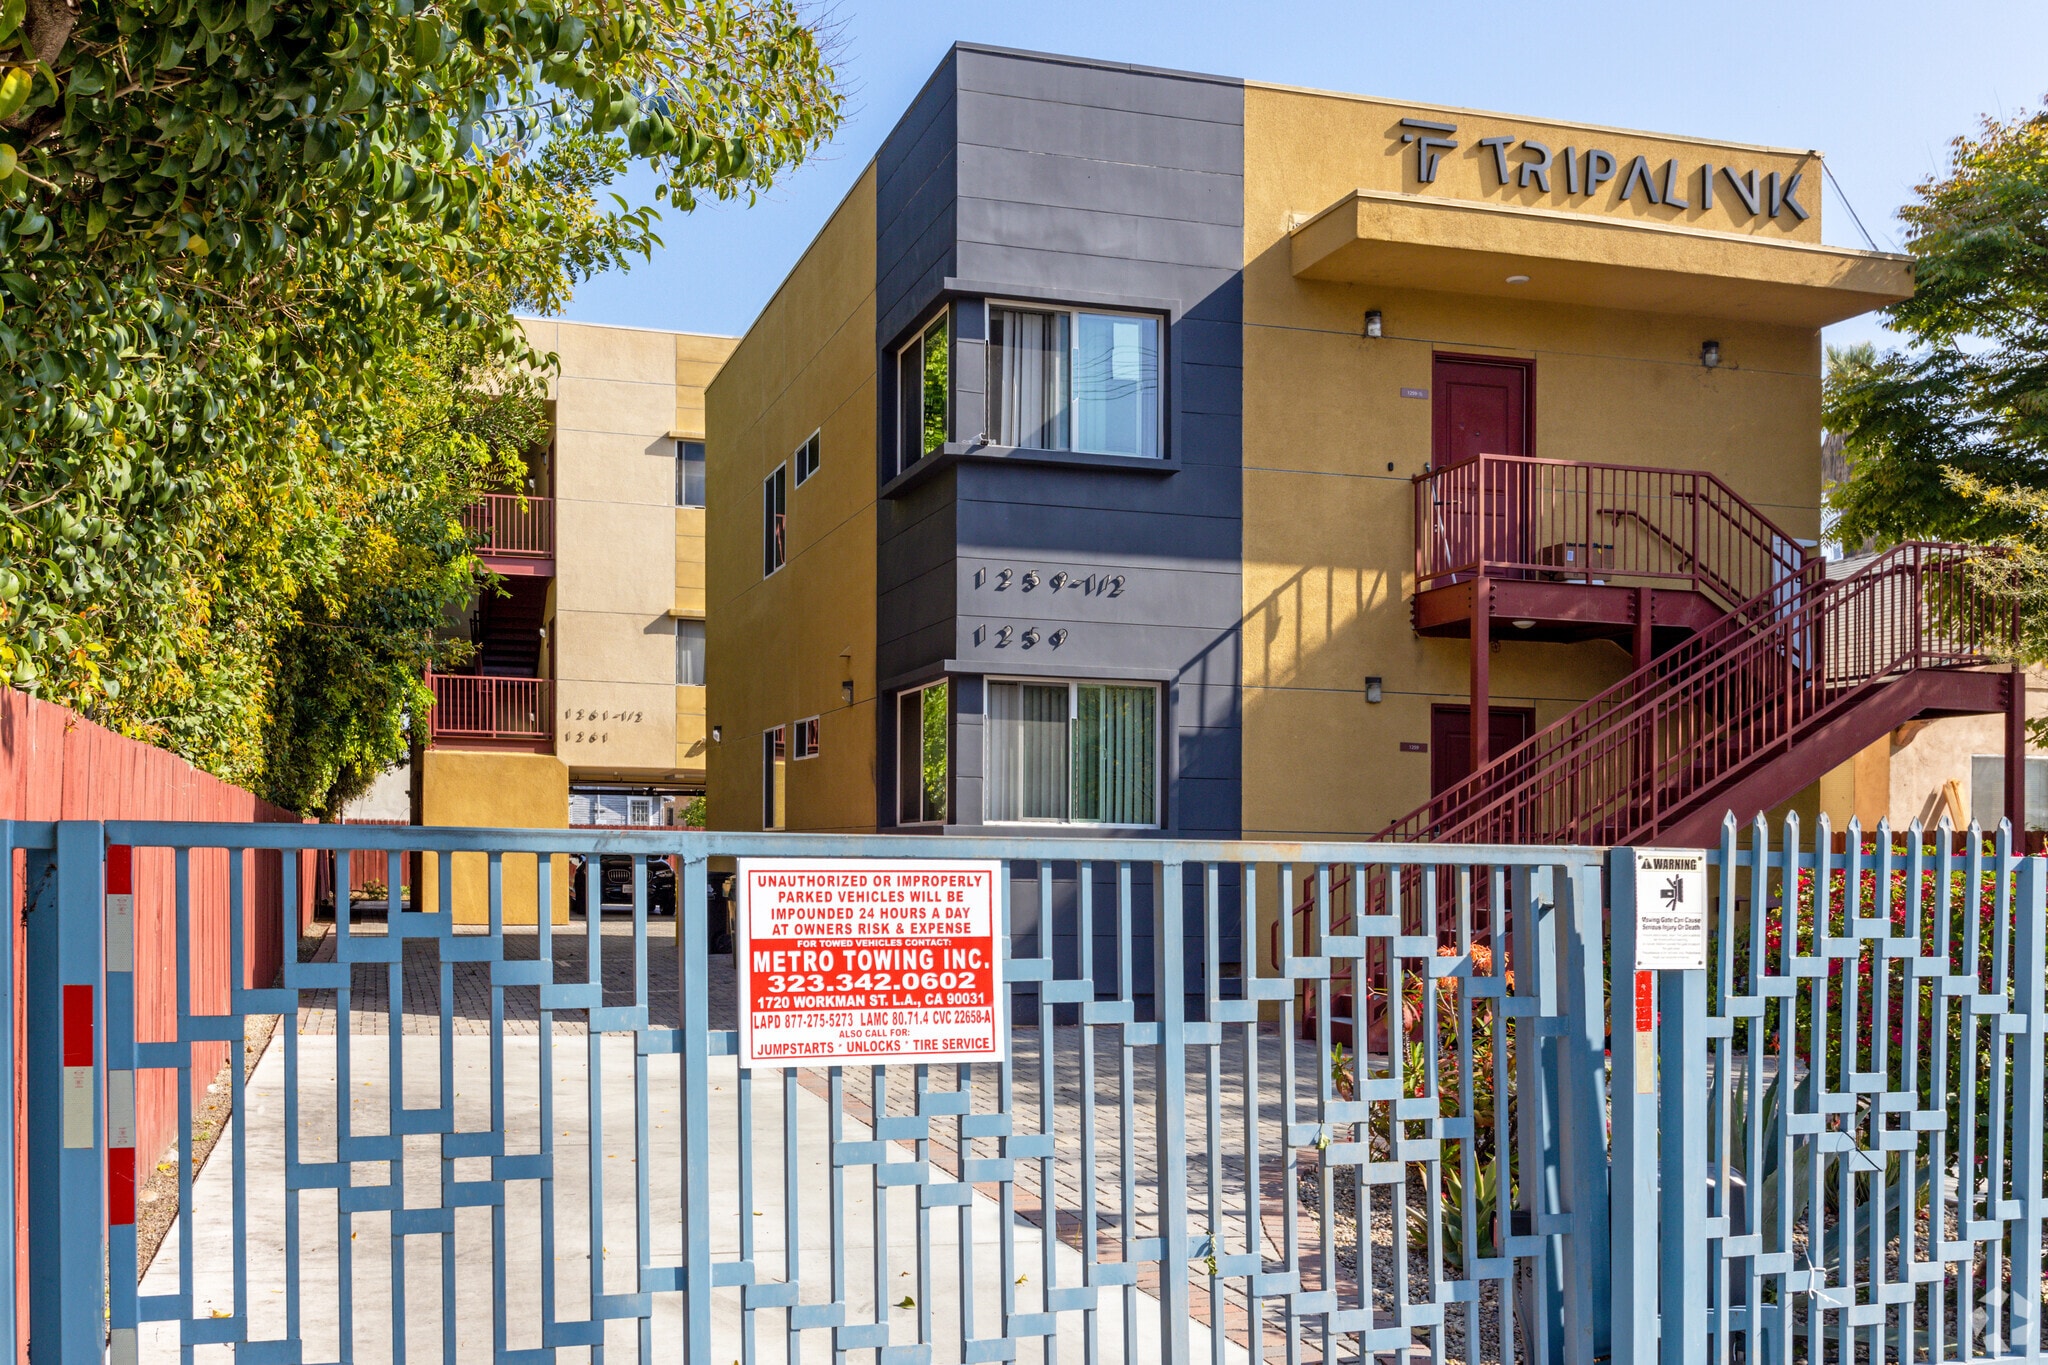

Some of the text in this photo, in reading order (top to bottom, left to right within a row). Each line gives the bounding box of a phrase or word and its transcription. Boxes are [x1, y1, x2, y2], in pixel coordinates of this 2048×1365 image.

[1479, 134, 1810, 220] TRIPALINK
[973, 624, 1068, 651] 1259
[565, 731, 608, 743] 1261
[1654, 859, 1696, 870] WARNING
[758, 875, 982, 887] UNAUTHORIZED OR IMPROPERLY
[778, 891, 963, 903] PARKED VEHICLES WILL BE
[771, 908, 970, 920] IMPOUNDED 24 HOURS A DAY
[772, 923, 971, 935] AT OWNERS RISK & EXPENSE
[797, 940, 817, 948] FOR
[855, 939, 902, 947] VEHICLES
[904, 939, 951, 947] CONTACT:
[753, 949, 990, 973] METRO TOWING INC.
[768, 972, 975, 992] 323.342.0602
[758, 992, 985, 1009] 1720 WORKMAN ST. L.A., CA 90031
[754, 1010, 990, 1029] LAPD 877-275-5273 LAMC 80.71.4 CVC 22658-A
[839, 1028, 910, 1038] ALSO CALL FOR:
[758, 1038, 989, 1056] JUMPSTARTS UNLOCKS TIRE SERVICE
